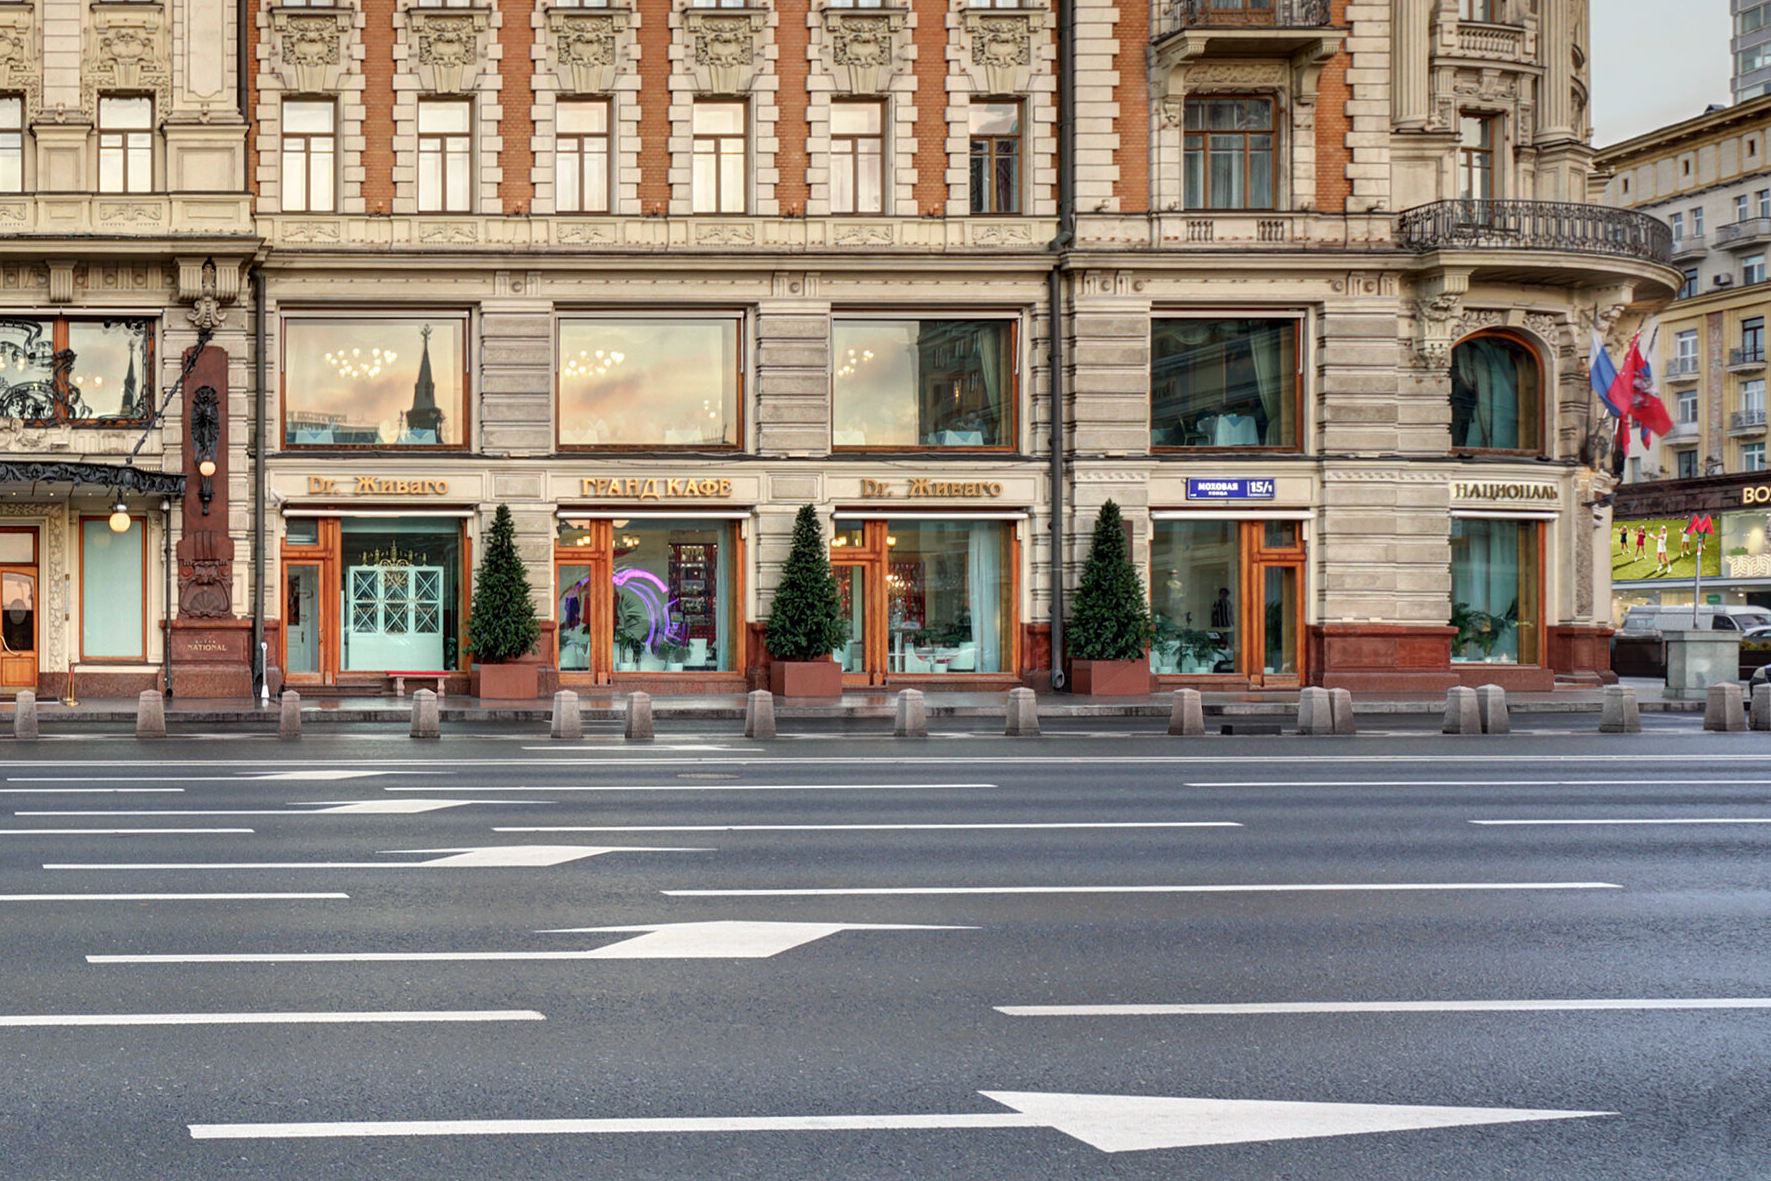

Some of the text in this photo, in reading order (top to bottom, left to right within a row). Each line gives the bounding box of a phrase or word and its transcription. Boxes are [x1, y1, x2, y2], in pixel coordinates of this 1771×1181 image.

[308, 475, 450, 495] Dr. Живаго
[580, 477, 733, 500] ГРАНД КАФЕ
[860, 478, 1004, 498] Dr. Живаго
[1198, 482, 1239, 491] МОХОВАЯ
[1250, 481, 1273, 494] 15/1
[1454, 483, 1558, 501] НАЦИОНАЛЬ
[1742, 486, 1771, 504] BO
